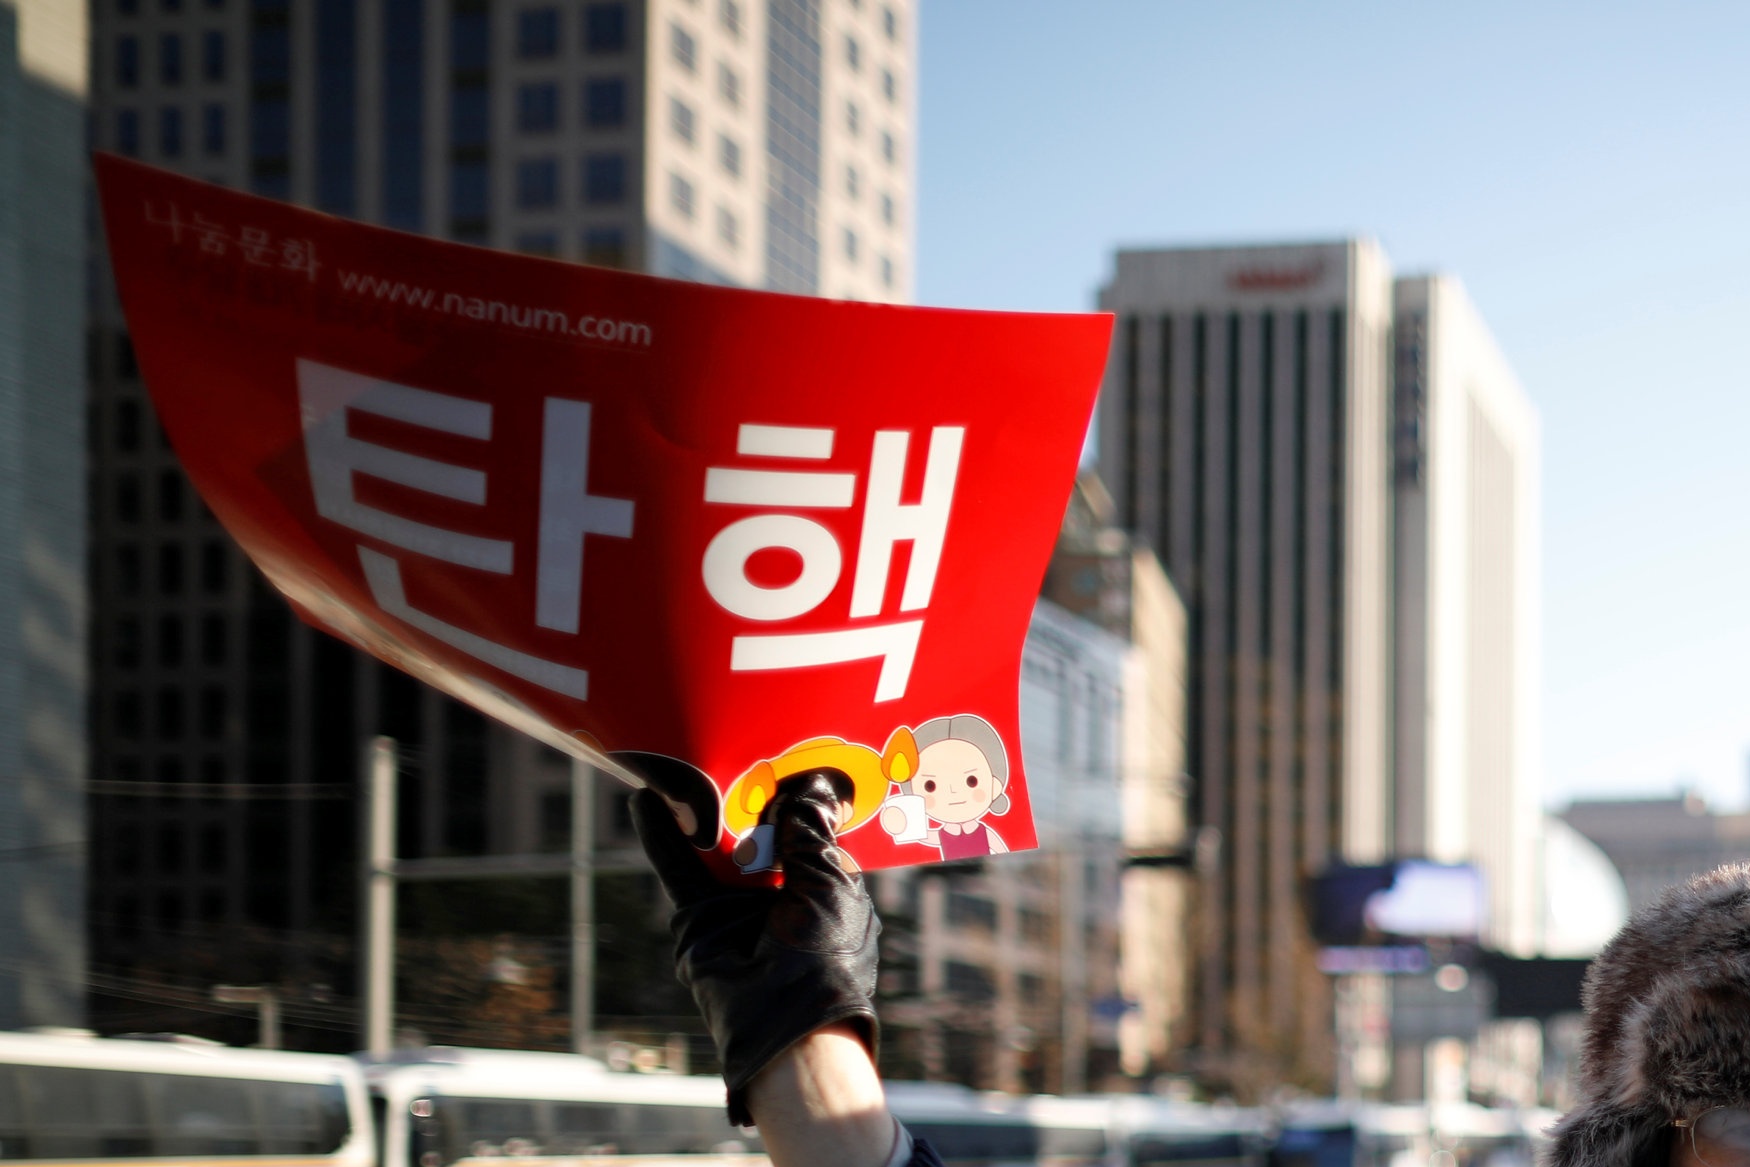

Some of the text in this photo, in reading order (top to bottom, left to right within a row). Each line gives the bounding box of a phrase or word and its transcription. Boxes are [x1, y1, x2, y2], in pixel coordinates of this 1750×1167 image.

[143, 199, 654, 347] 나눔문화 www.nanum.com
[296, 356, 966, 703] 탄핵
